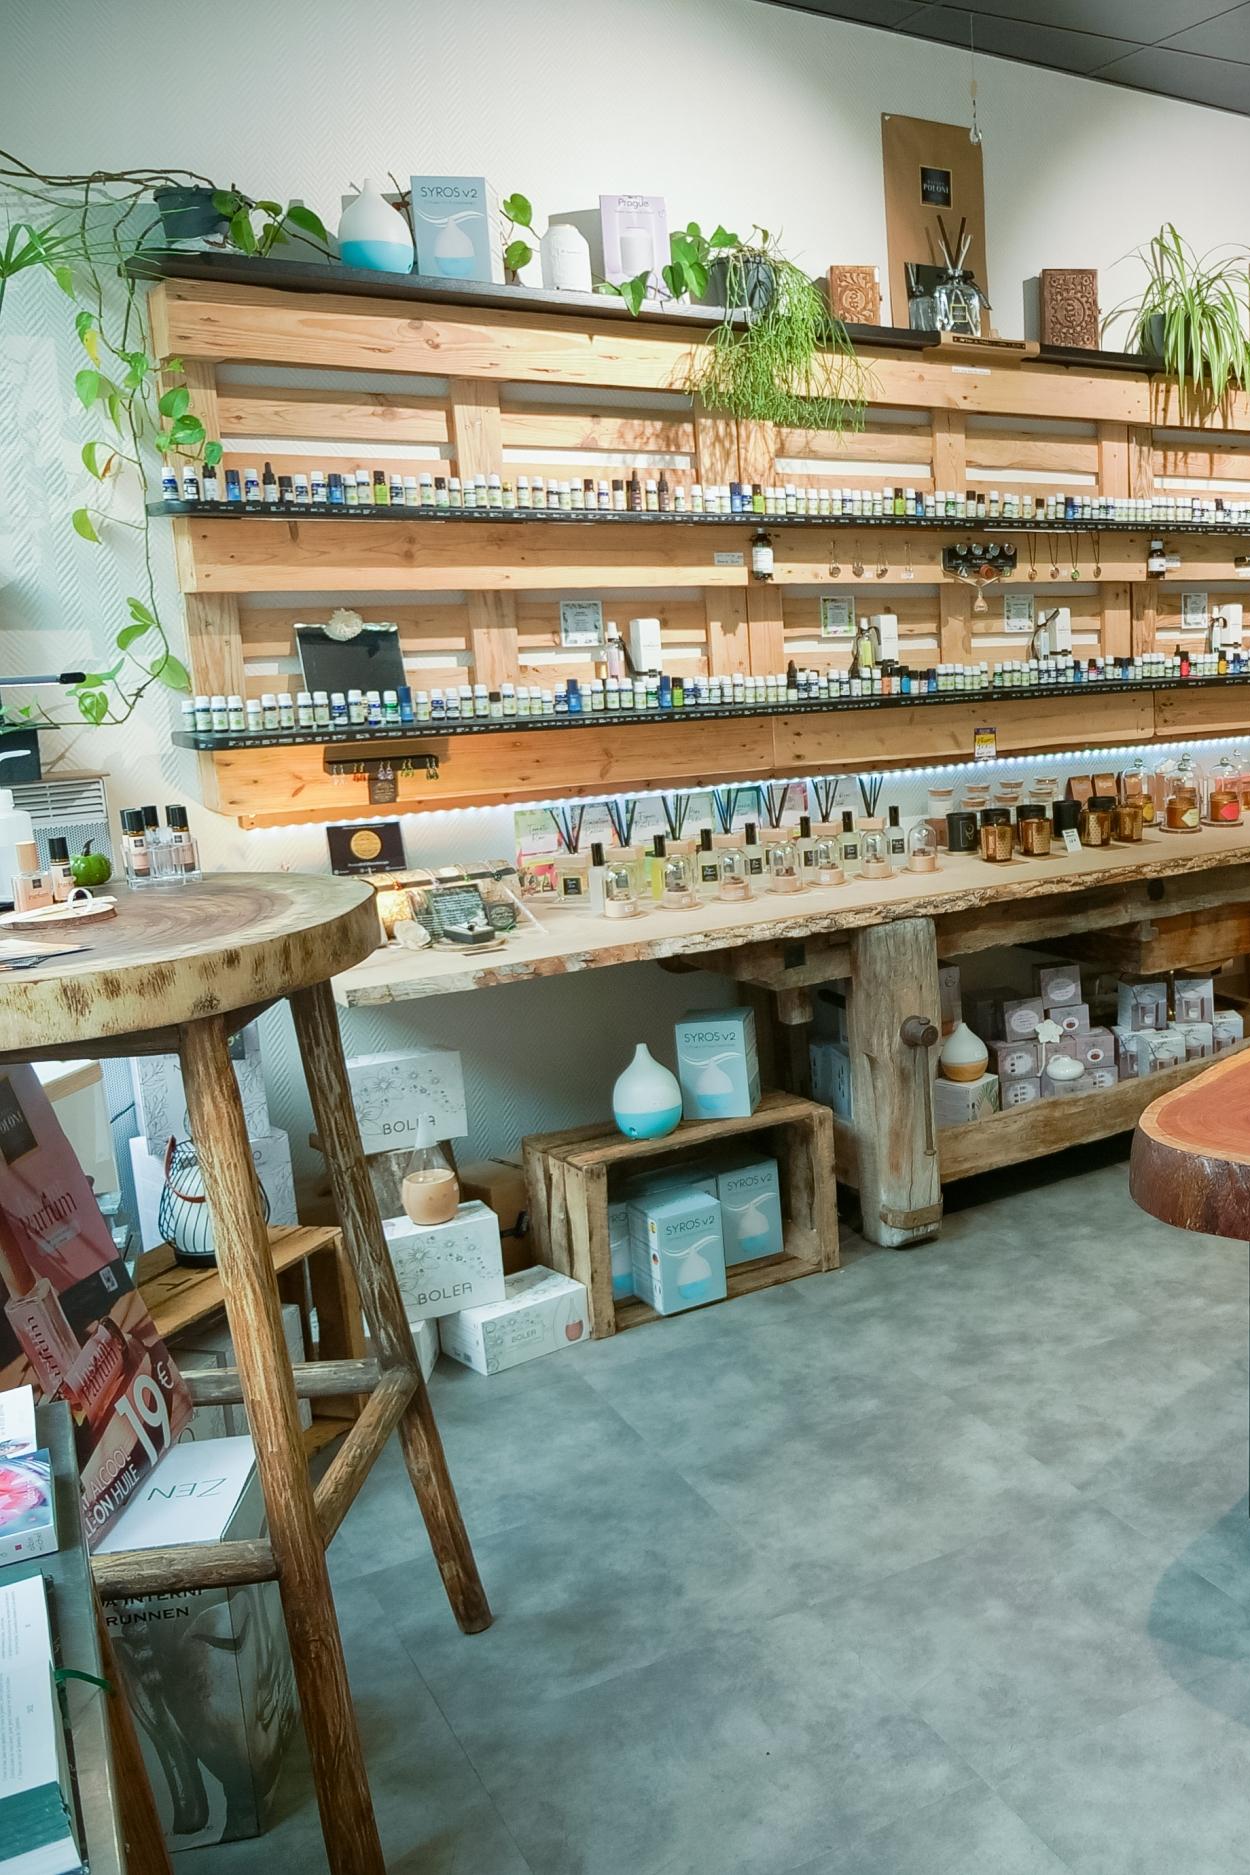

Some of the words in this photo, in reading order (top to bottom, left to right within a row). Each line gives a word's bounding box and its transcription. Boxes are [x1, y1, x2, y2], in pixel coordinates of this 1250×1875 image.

[420, 186, 460, 198] SYROS
[462, 188, 478, 199] v2
[618, 196, 649, 208] Prague
[684, 1032, 720, 1043] SYROS
[722, 1031, 736, 1041] v2
[727, 1175, 759, 1191] SYROS
[760, 1172, 773, 1183] v2
[665, 1218, 701, 1236] SYROS
[702, 1215, 715, 1227] v2
[418, 1282, 473, 1305] BOLEA
[511, 1329, 537, 1343] BOLEA
[90, 1447, 132, 1497] ALCOOL
[110, 1463, 141, 1505] HUILE
[148, 1478, 227, 1502] ZEN
[106, 1607, 185, 1627] RUNNEN
